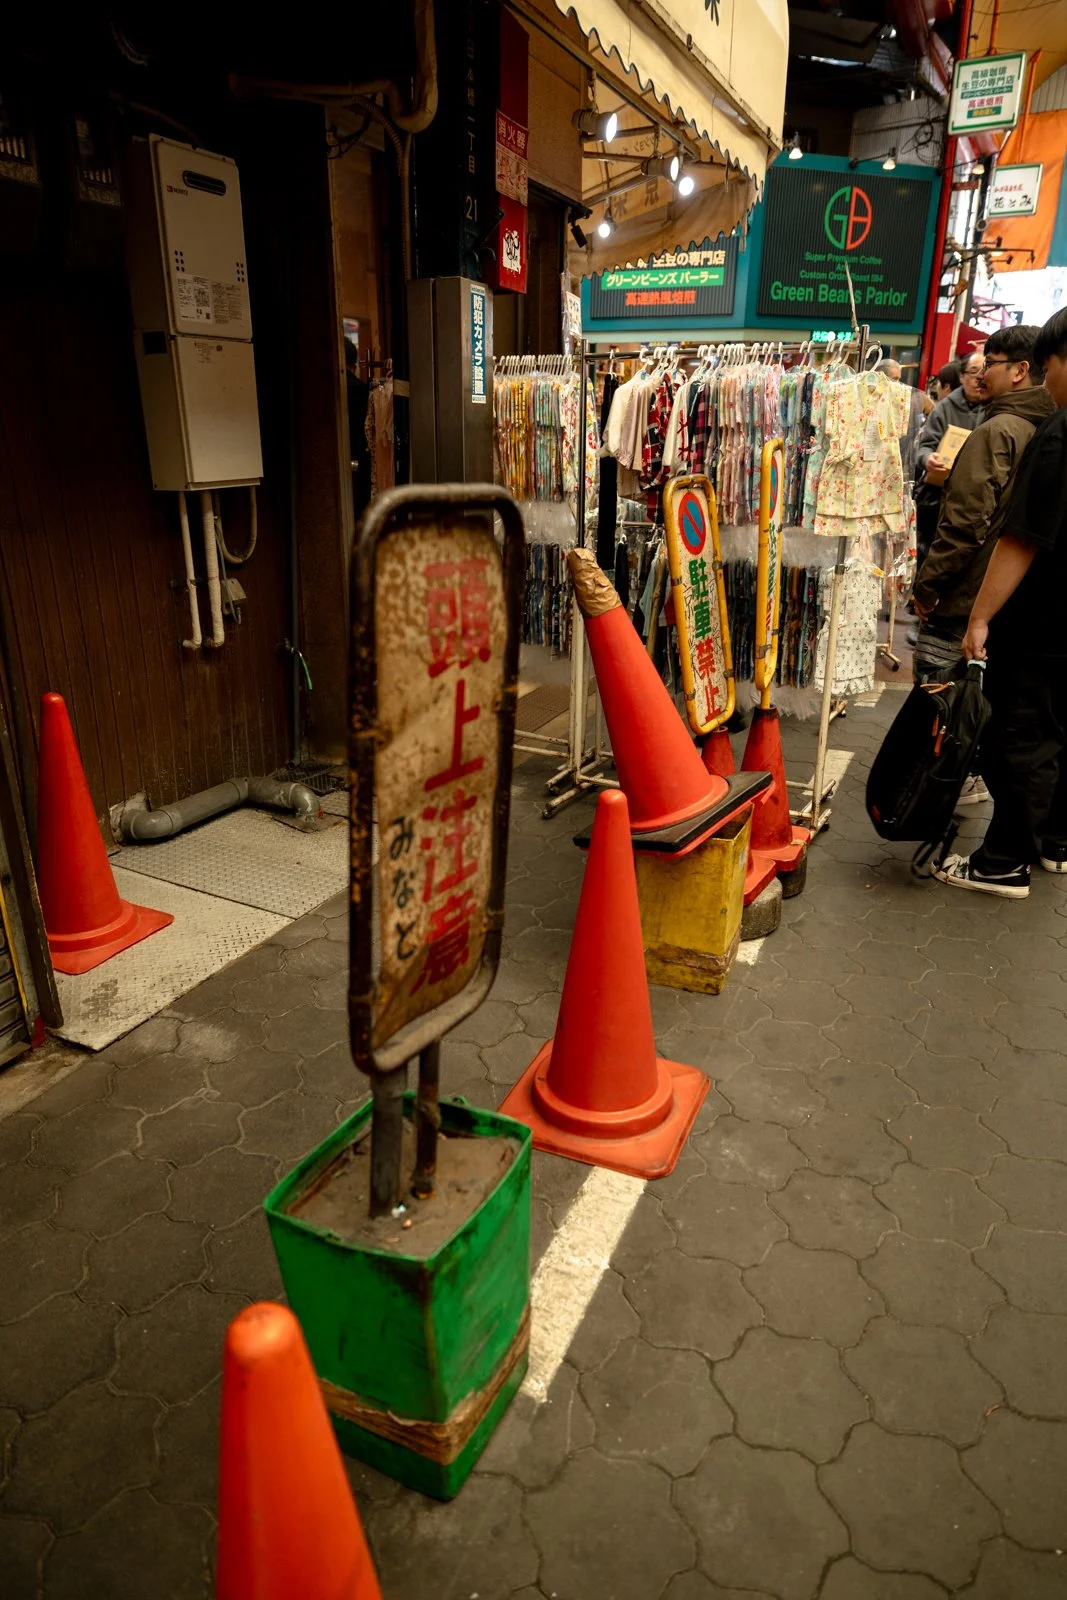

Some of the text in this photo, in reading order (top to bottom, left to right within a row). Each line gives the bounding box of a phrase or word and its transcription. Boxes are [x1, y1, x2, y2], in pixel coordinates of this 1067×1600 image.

[498, 117, 526, 150] 消火器
[606, 270, 720, 287] グリーンビーンズ パーラー
[770, 281, 908, 307] Green Beans Parlor
[473, 294, 484, 395] 防犯カメラ設置
[688, 556, 722, 723] 駐車禁止
[410, 556, 492, 997] 頭上注意
[388, 815, 417, 962] みなと
